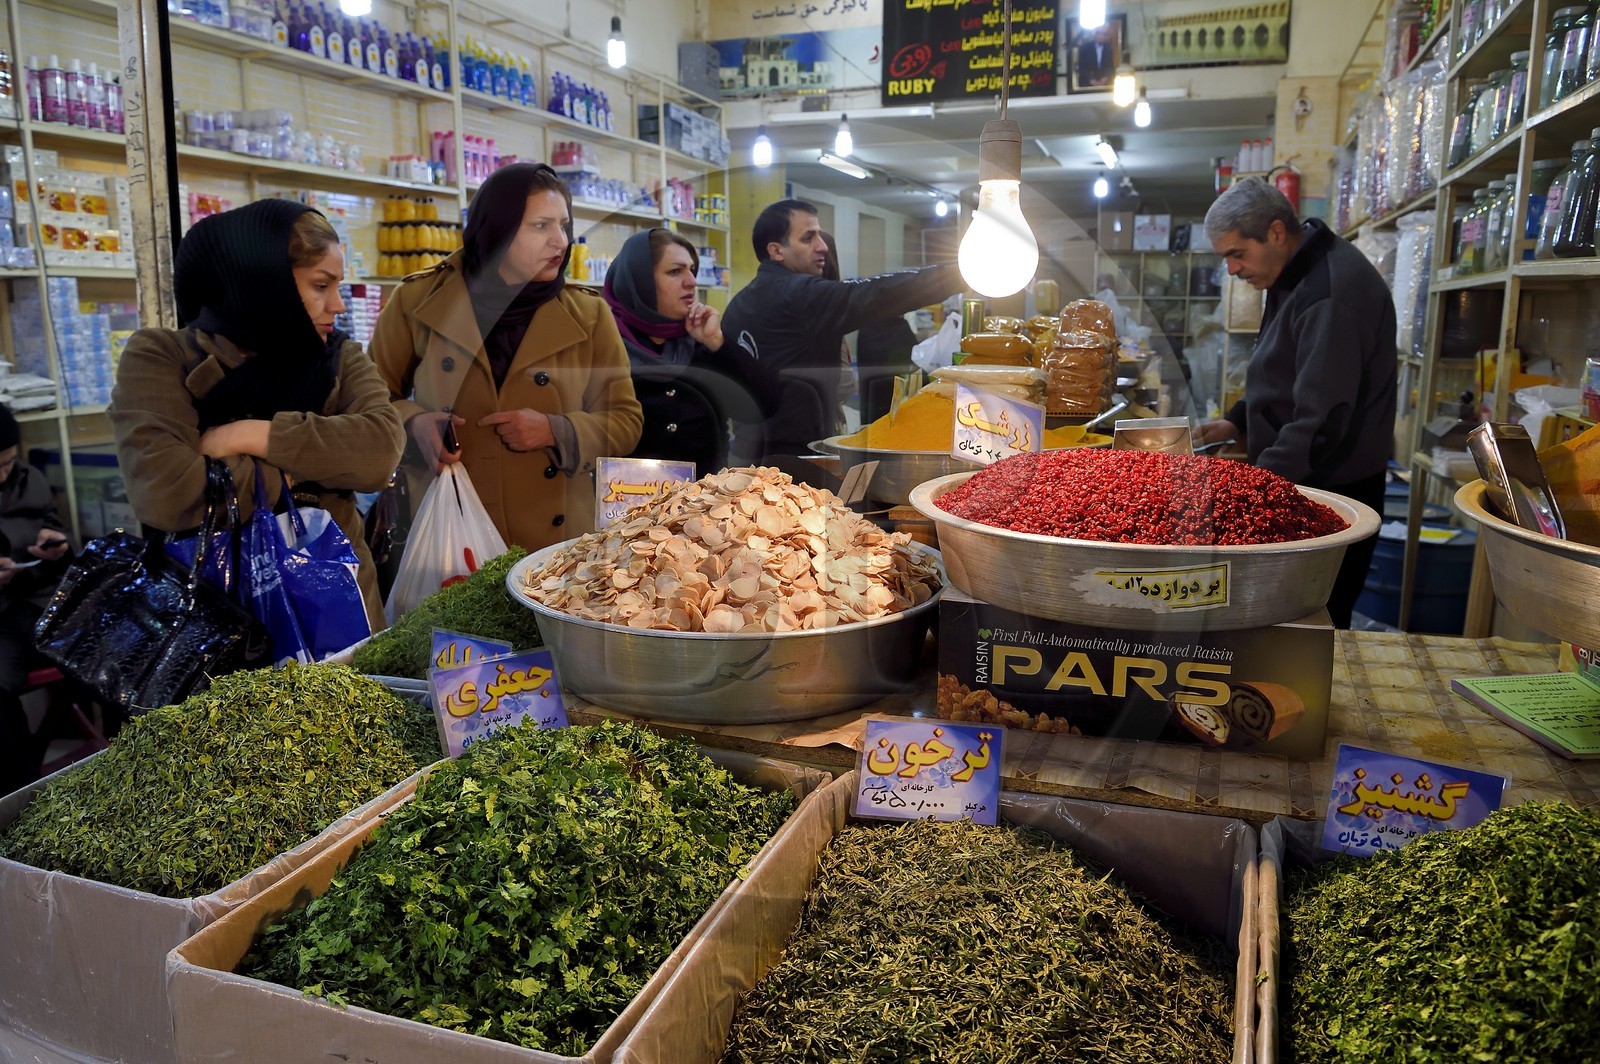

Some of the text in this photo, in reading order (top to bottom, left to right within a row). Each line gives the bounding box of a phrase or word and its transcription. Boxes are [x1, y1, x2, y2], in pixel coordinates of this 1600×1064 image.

[888, 78, 936, 96] RUBY
[957, 402, 1032, 453] زرشک
[602, 480, 676, 503] وسیر
[1204, 579, 1221, 597] بر
[975, 640, 989, 684] RAISIN
[992, 627, 1234, 661] First Full-Automatically produced Raisin
[446, 663, 553, 718] جعفری
[991, 644, 1232, 707] PARS
[867, 727, 993, 782] ترخون
